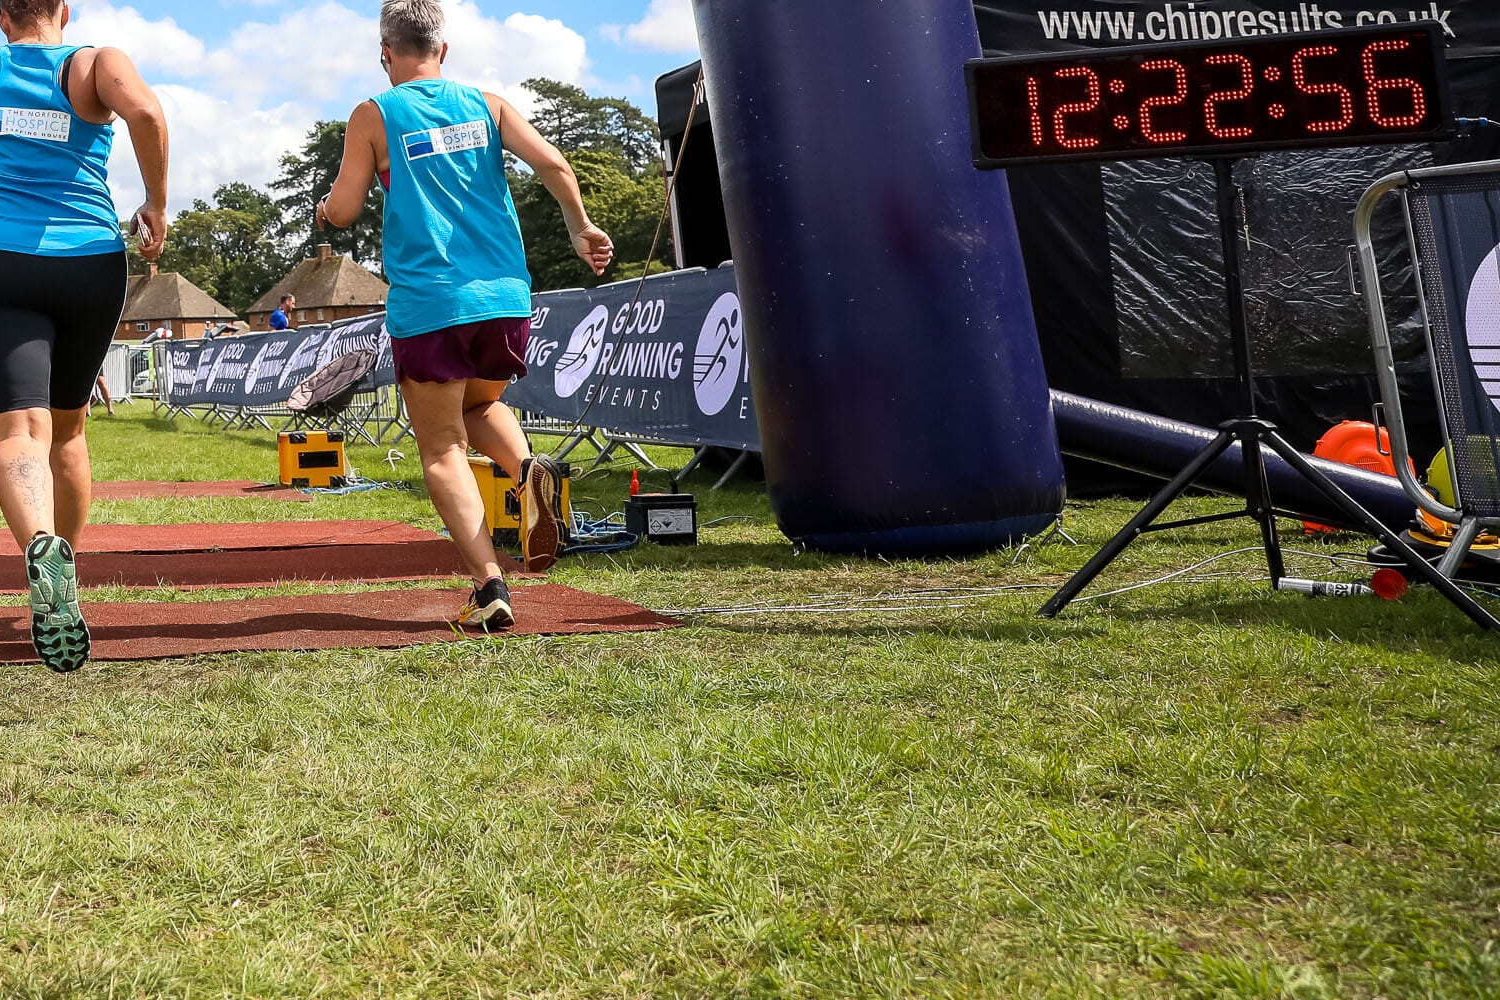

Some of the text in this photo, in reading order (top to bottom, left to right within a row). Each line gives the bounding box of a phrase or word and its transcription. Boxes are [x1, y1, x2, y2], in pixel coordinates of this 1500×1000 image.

[1027, 40, 1426, 148] 12:22:56
[5, 116, 68, 133] HOSPICE
[28, 111, 69, 120] NORFOLK
[41, 132, 67, 140] HOUSE
[611, 299, 665, 335] GOOD
[595, 341, 684, 380] RUNNING
[584, 384, 662, 411] EVENTS
